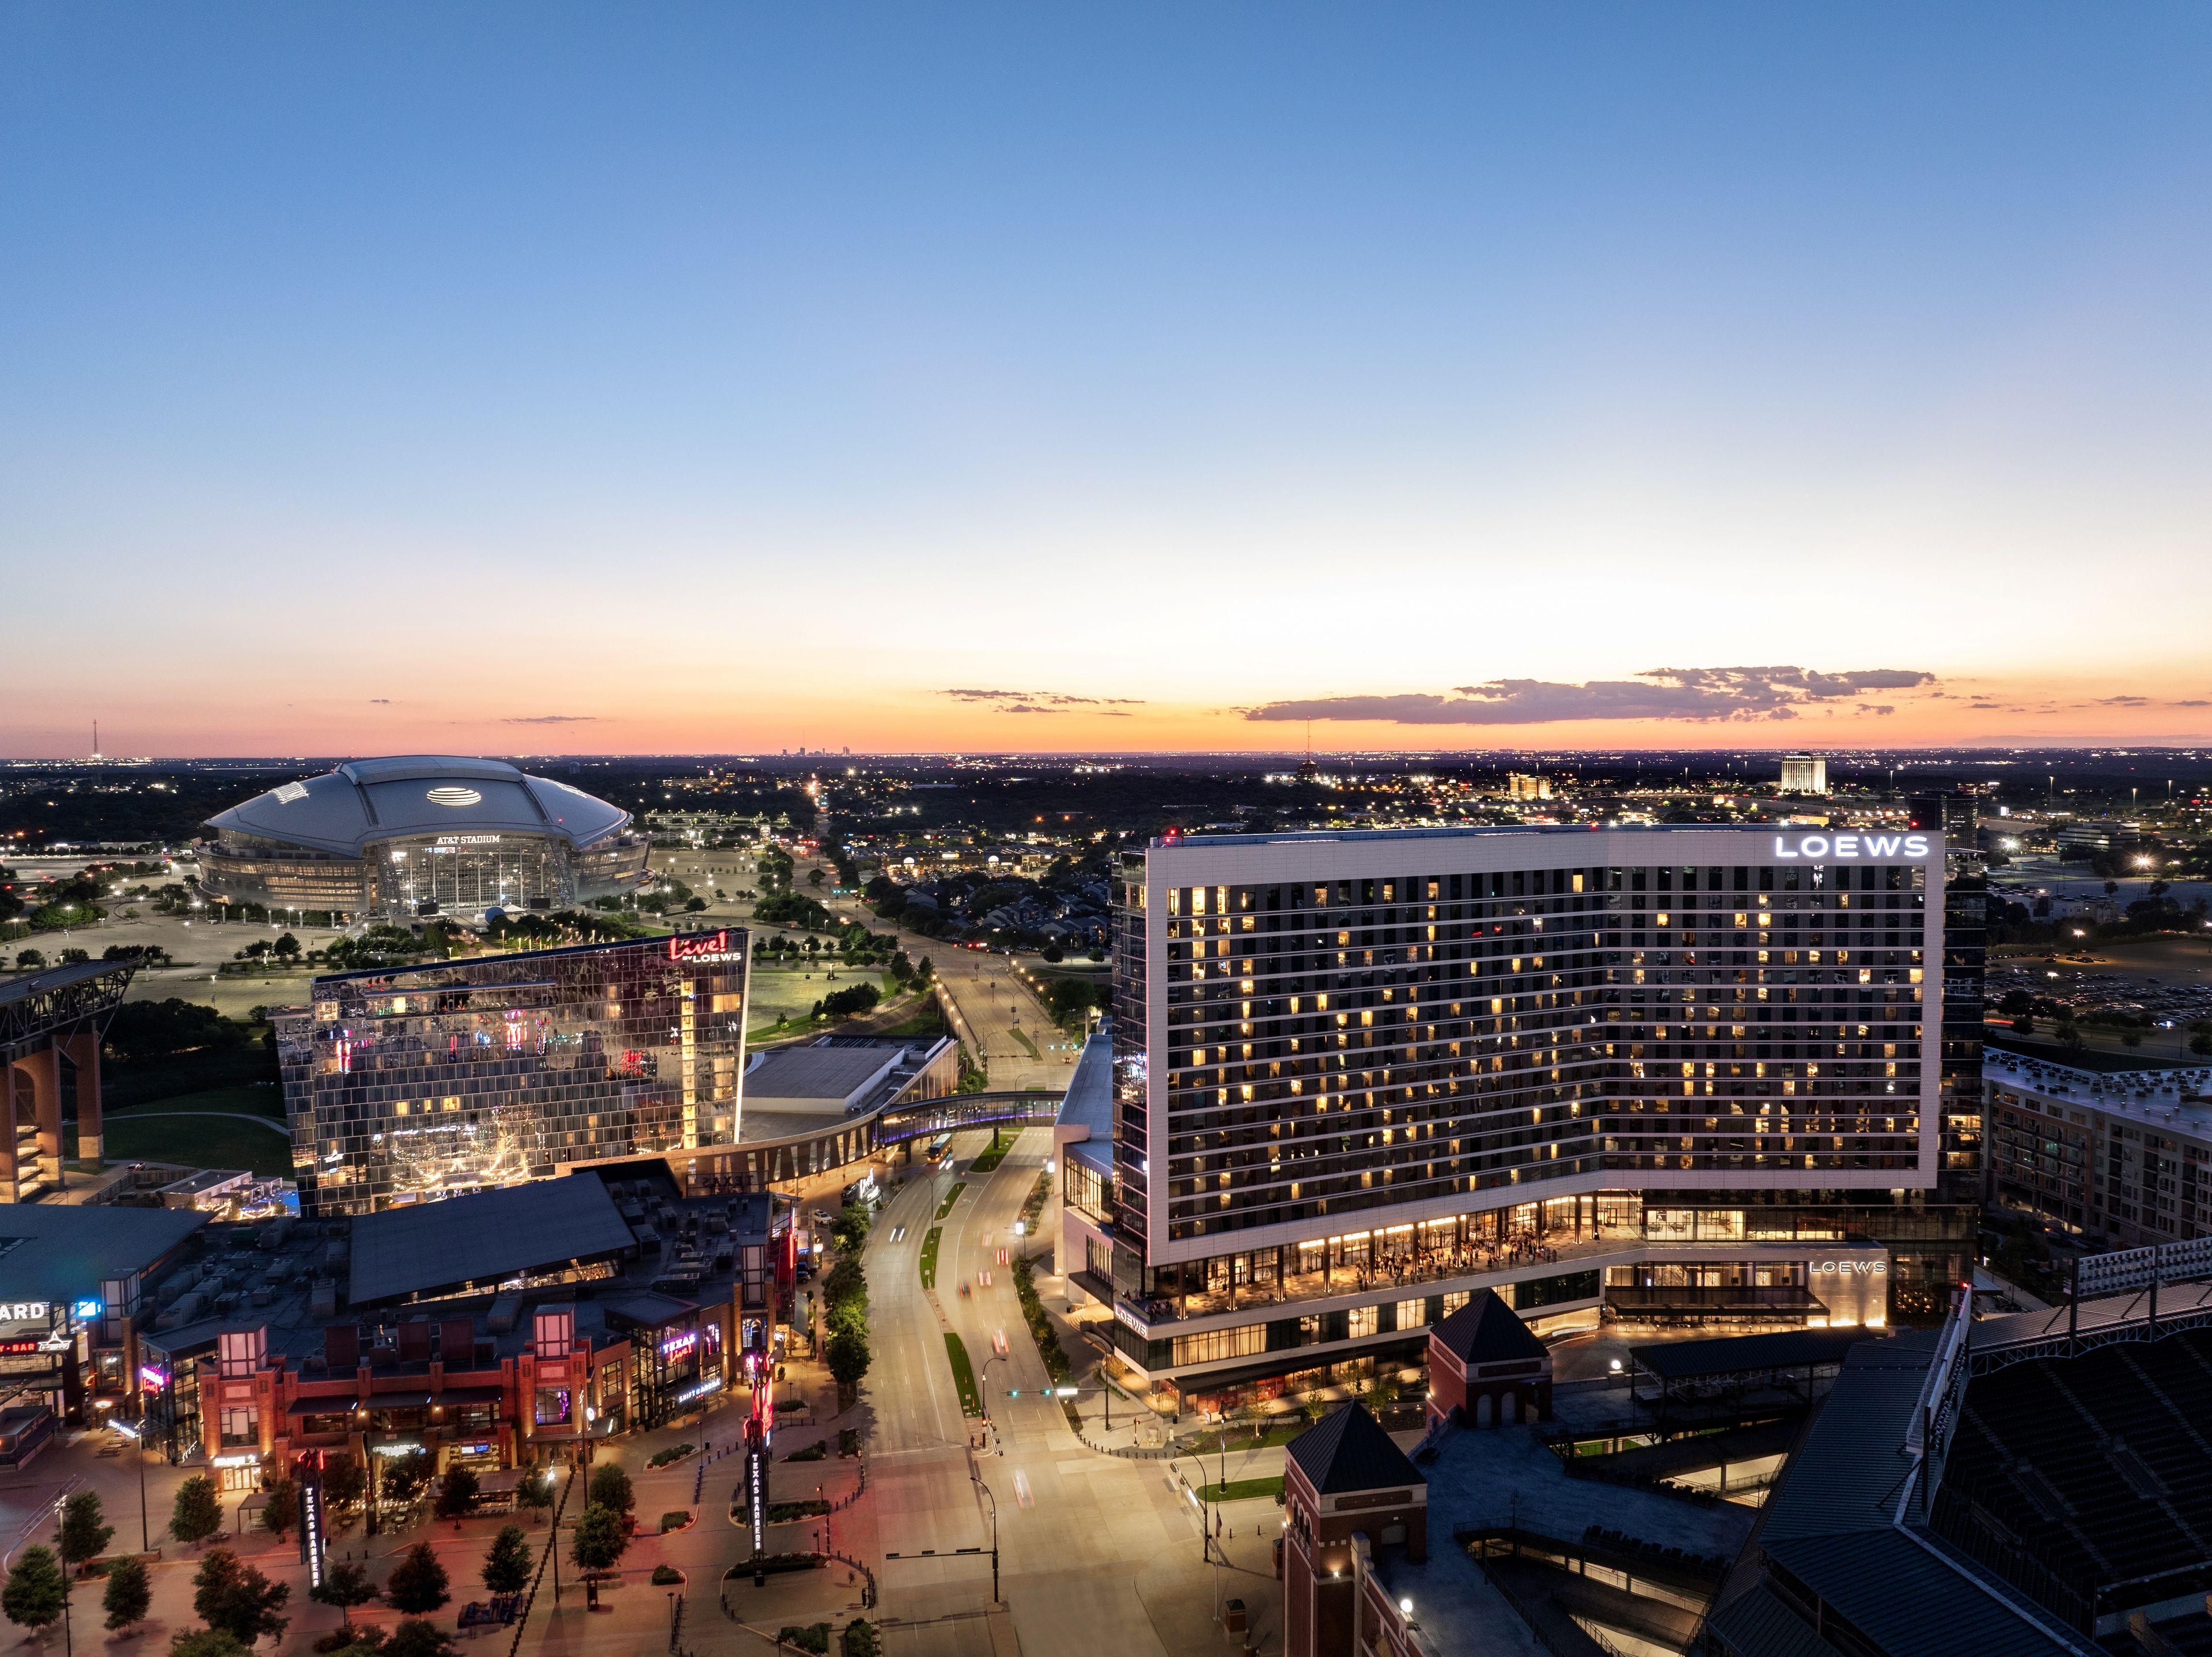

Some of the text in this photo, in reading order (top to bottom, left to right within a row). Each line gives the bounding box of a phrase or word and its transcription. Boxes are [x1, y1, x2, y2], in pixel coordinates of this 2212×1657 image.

[436, 835, 500, 845] AT&T STADIUM
[1776, 836, 1929, 857] LOEWS
[670, 931, 726, 960] Live!
[693, 953, 741, 963] LOEWS
[1809, 1261, 1887, 1273] LOEWS
[1115, 1306, 1147, 1337] LOEWS
[13, 1343, 35, 1352] BAR
[663, 1334, 695, 1354] TEXAS
[669, 1343, 692, 1363] Live!
[306, 1488, 315, 1530] TEXAS
